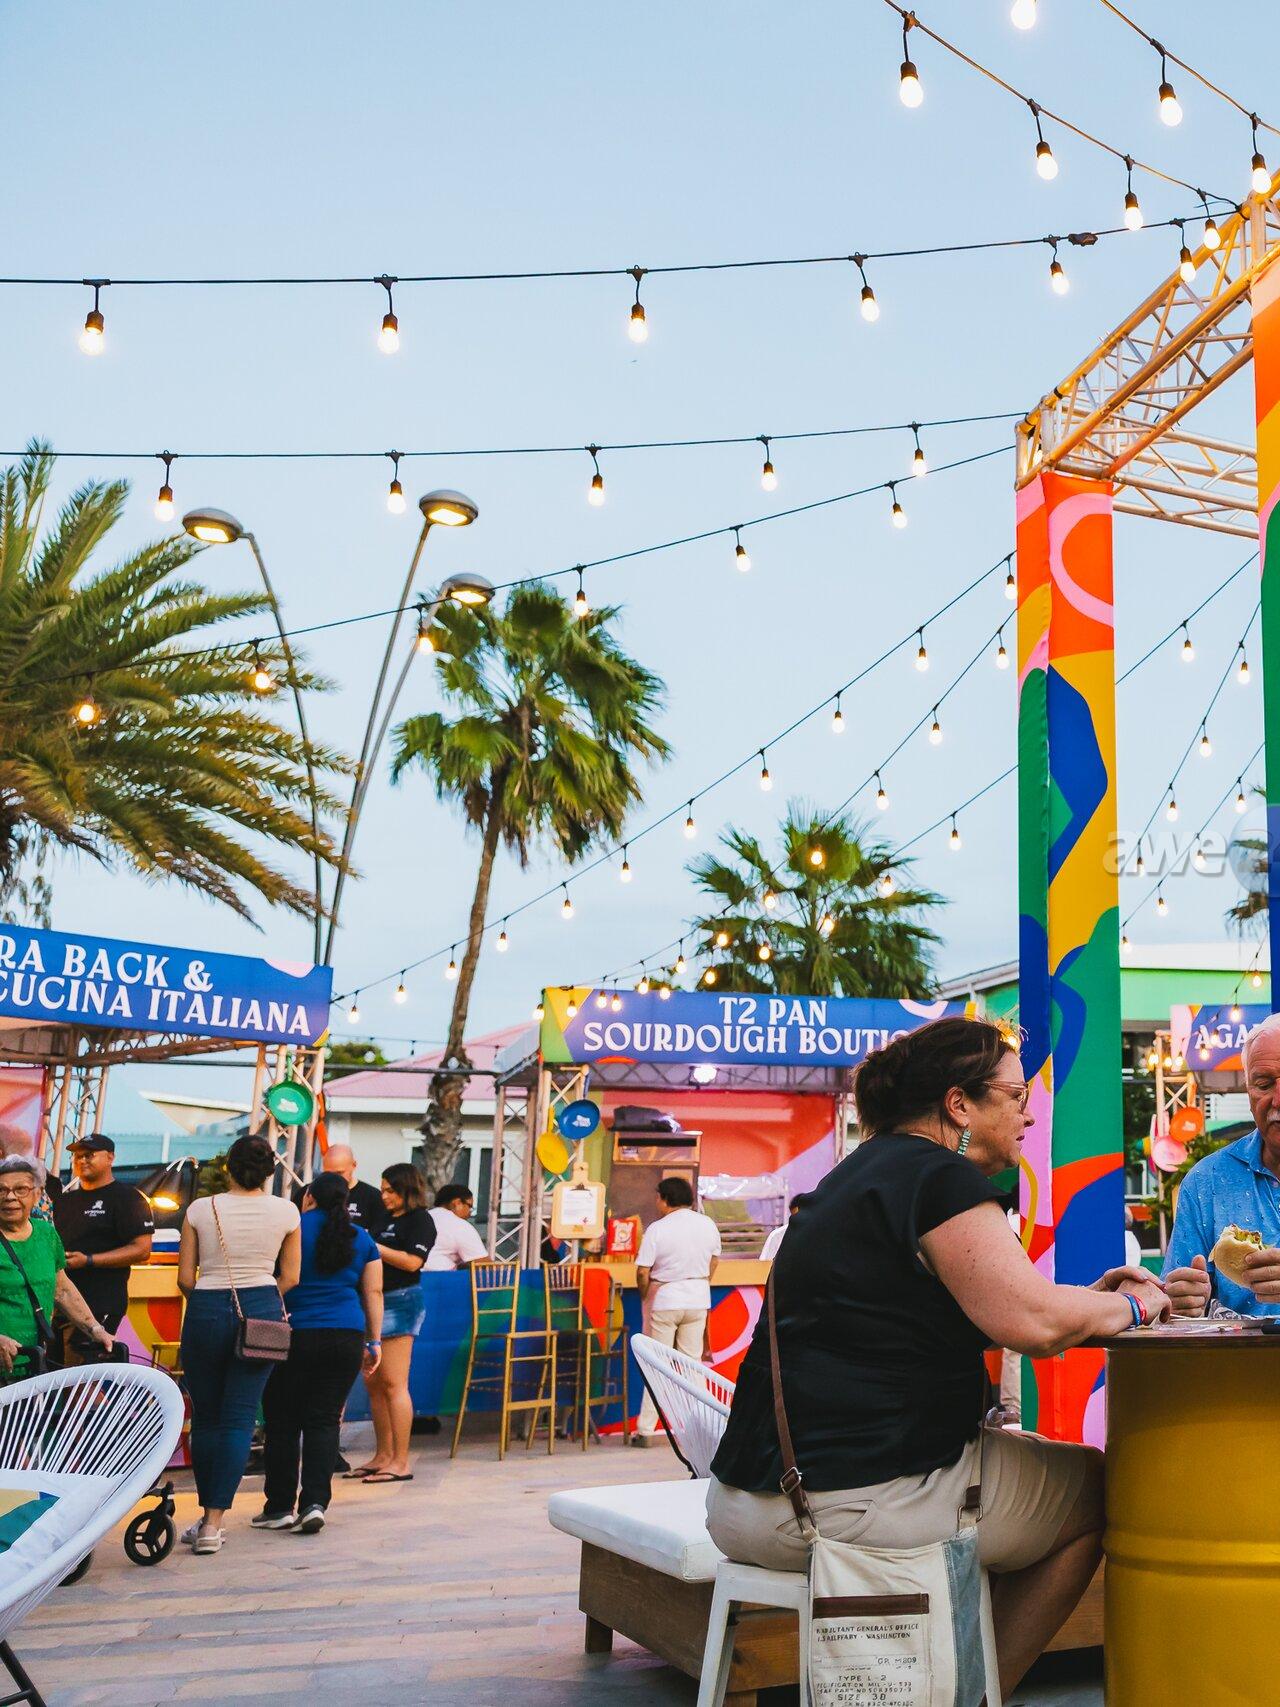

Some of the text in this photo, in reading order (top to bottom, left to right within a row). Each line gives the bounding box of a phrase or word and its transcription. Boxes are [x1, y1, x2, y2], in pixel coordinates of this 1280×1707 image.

[62, 943, 170, 988] BACK
[183, 959, 214, 993] &
[147, 988, 311, 1036] ITALIANA
[718, 996, 827, 1027] T2 PAN
[583, 1022, 787, 1054] SOURDOUGH
